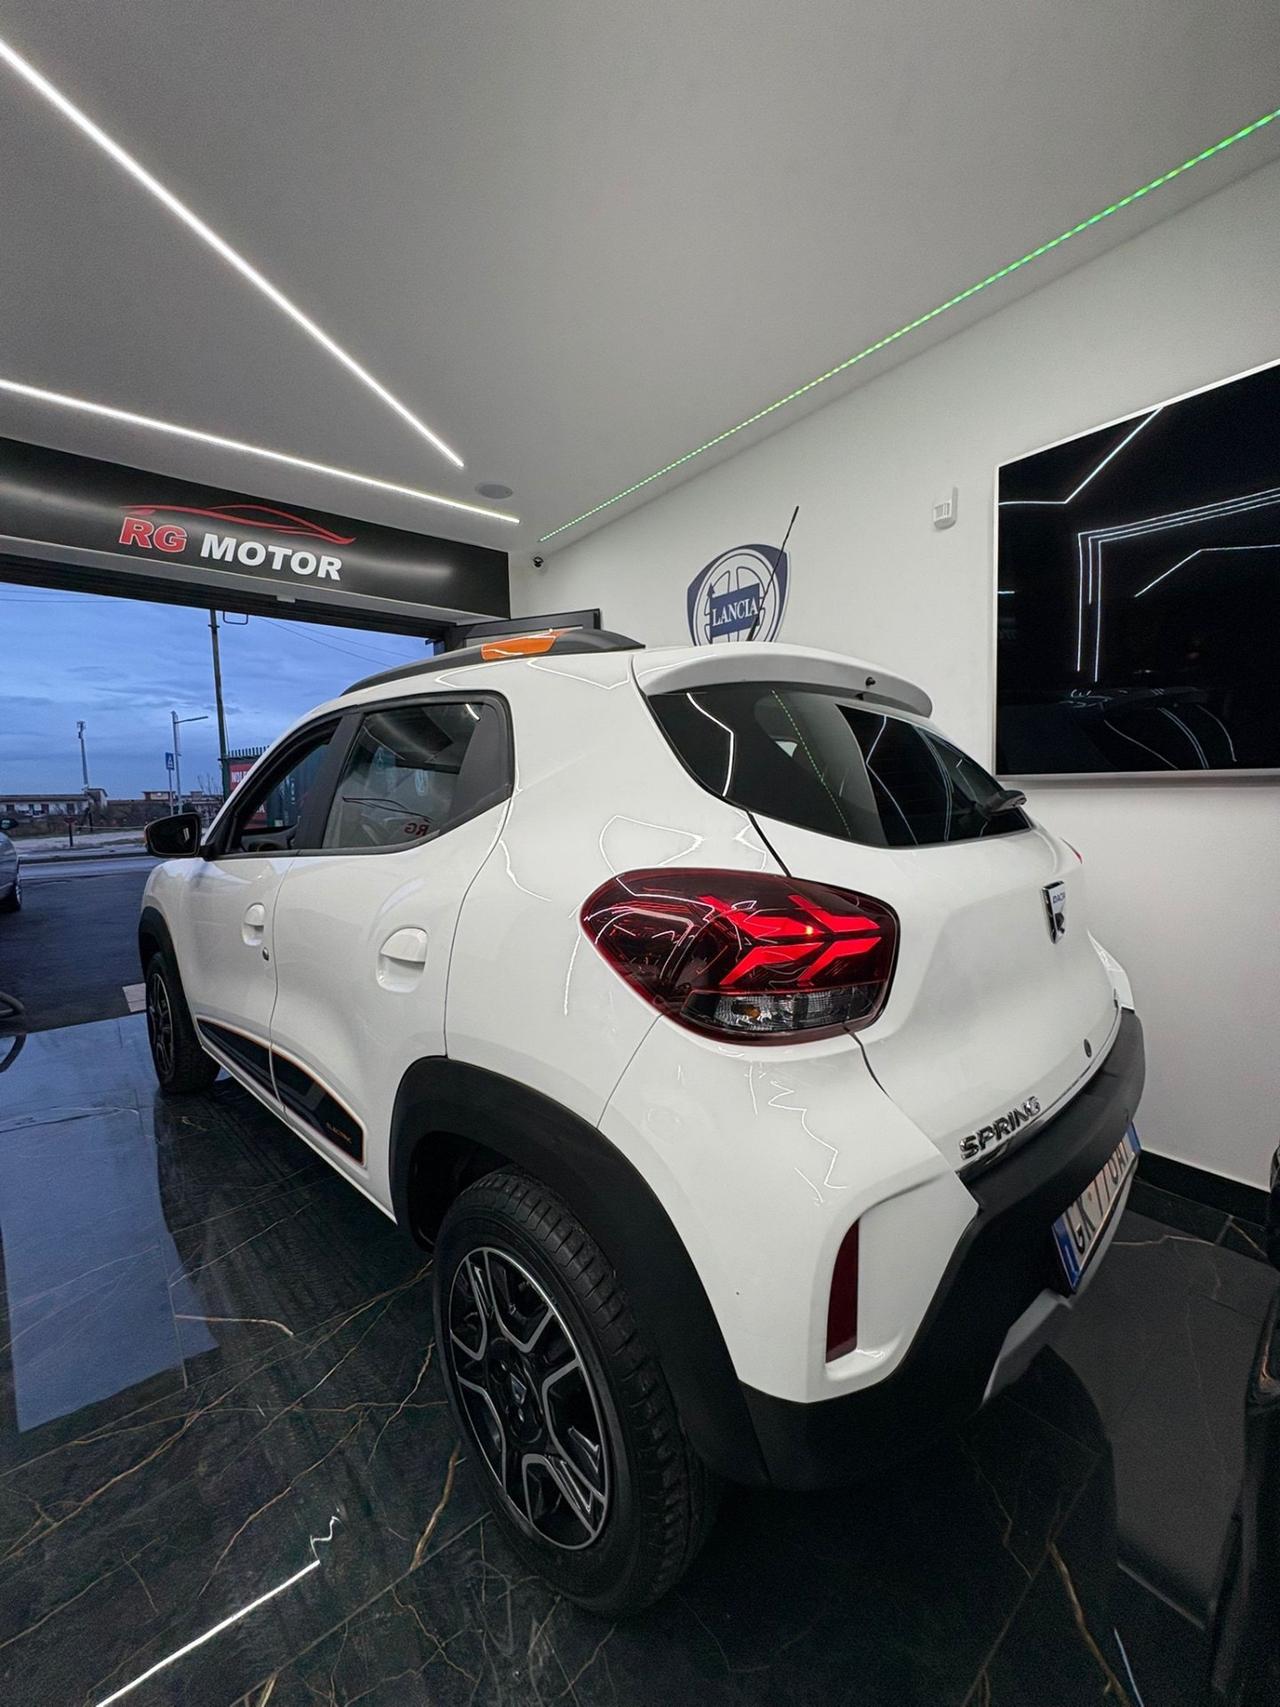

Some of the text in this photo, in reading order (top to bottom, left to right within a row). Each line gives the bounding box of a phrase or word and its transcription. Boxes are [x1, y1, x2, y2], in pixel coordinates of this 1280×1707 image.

[119, 517, 342, 581] RG MOTOR
[712, 597, 758, 627] LANCIA
[960, 1096, 1040, 1160] SPRING
